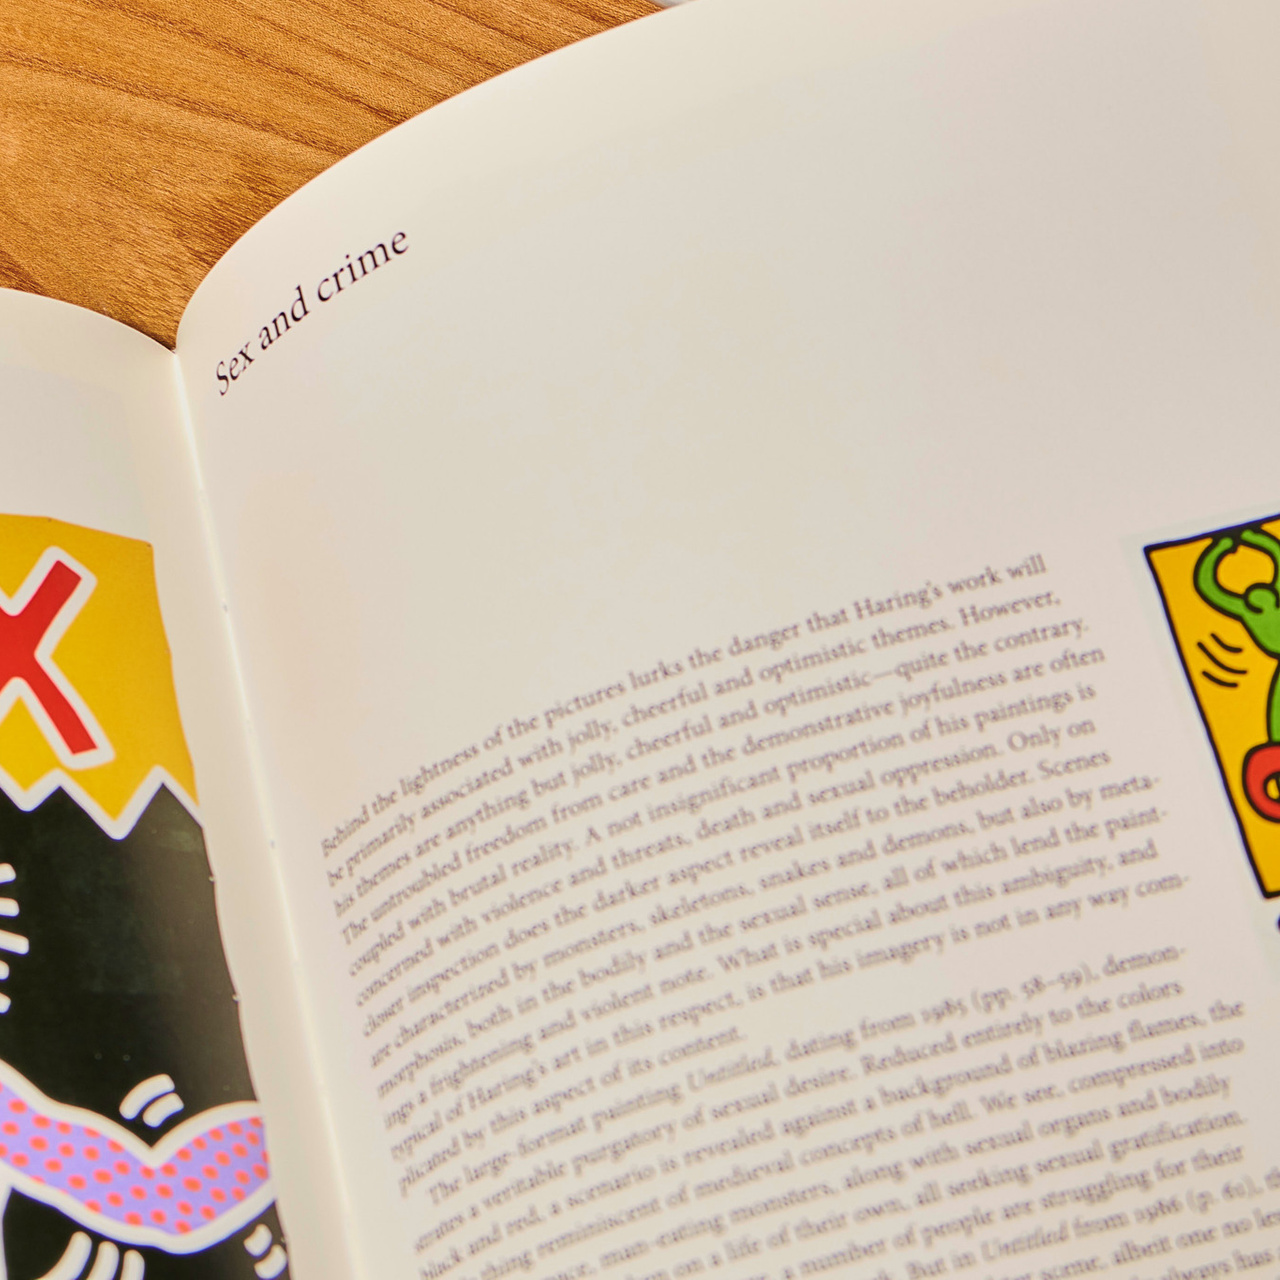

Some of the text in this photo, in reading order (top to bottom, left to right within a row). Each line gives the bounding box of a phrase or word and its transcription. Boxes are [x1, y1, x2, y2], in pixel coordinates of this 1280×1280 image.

[216, 231, 409, 396] Sex and crime
[345, 812, 416, 878] primarily
[421, 756, 514, 820] associated
[517, 737, 564, 768] with
[621, 681, 709, 727] cheerful
[714, 666, 754, 696] and
[758, 639, 867, 684] optimistic
[355, 852, 412, 898] themes
[415, 833, 441, 858] are
[445, 789, 531, 840] anything
[530, 771, 567, 797] but
[625, 714, 713, 761] cheerful
[718, 699, 759, 729] and
[953, 640, 988, 662] the
[370, 850, 463, 923] untroubled
[465, 816, 548, 864] freedom
[550, 793, 604, 824] from
[607, 776, 650, 802] care
[657, 753, 698, 785] and
[700, 746, 736, 769] the
[741, 701, 894, 756] demonstrative
[899, 672, 1008, 716] joyfulness
[1013, 663, 1044, 683] are
[1049, 648, 1106, 673] often
[371, 790, 398, 815] the
[399, 745, 480, 797] lightness
[483, 725, 503, 751] of
[506, 716, 539, 739] the
[543, 682, 627, 730] pictures
[628, 660, 685, 690] lurks
[687, 648, 722, 670] the
[728, 624, 800, 657] danger
[805, 608, 849, 633] that
[947, 566, 1002, 594] work
[1006, 553, 1047, 579] will
[407, 898, 447, 930] with
[447, 863, 507, 907] brutal
[586, 826, 602, 846] A
[606, 811, 643, 838] not
[647, 765, 781, 823] insignificant
[785, 733, 906, 784] proportion
[909, 718, 932, 743] of
[934, 715, 970, 737] his
[973, 691, 1074, 733] paintings
[1076, 682, 1097, 701] is
[394, 967, 510, 1049] characterized
[511, 960, 538, 981] by
[759, 860, 831, 890] snakes
[836, 839, 878, 869] and
[975, 807, 1015, 830] but
[1021, 796, 1064, 820] also
[1064, 787, 1093, 811] by
[407, 943, 501, 1004] inspection
[503, 920, 551, 950] does
[553, 904, 587, 927] the
[592, 876, 660, 912] darker
[667, 850, 734, 886] aspect
[739, 825, 805, 862] reveal
[808, 808, 861, 841] itself
[865, 807, 890, 825] to
[893, 795, 928, 817] the
[1036, 751, 1111, 780] Scenes
[436, 916, 478, 948] with
[480, 879, 563, 924] violence
[568, 855, 608, 888] and
[695, 806, 757, 840] death
[762, 790, 803, 820] and
[807, 769, 876, 806] sexual
[1006, 724, 1061, 752] Only
[1066, 719, 1096, 738] on
[465, 1004, 513, 1039] both
[516, 996, 539, 1015] in
[541, 979, 575, 1003] the
[653, 930, 694, 961] and
[697, 923, 733, 945] the
[739, 895, 808, 932] sexual
[882, 865, 910, 891] all
[913, 857, 937, 882] of
[940, 842, 1009, 873] which
[1009, 826, 1061, 857] lend
[1064, 821, 1099, 844] the
[418, 1091, 428, 1105] a
[429, 1033, 536, 1097] frightening
[538, 1008, 578, 1042] and
[580, 983, 654, 1022] violent
[716, 942, 779, 972] What
[784, 939, 804, 955] is
[807, 908, 883, 952] special
[888, 894, 949, 925] about
[952, 884, 996, 907] this
[1118, 838, 1159, 867] and
[445, 1096, 465, 1123] of
[552, 1046, 582, 1071] art
[585, 1038, 609, 1057] in
[612, 1023, 655, 1047] this
[746, 986, 767, 1002] is
[769, 968, 814, 994] that
[816, 960, 853, 980] his
[856, 934, 945, 969] imagery
[950, 927, 970, 944] is
[973, 914, 1012, 938] not
[1015, 909, 1040, 927] in
[1045, 898, 1082, 920] any
[1087, 887, 1129, 907] way
[461, 1128, 486, 1149] by
[489, 1109, 528, 1135] this
[532, 1077, 596, 1116] aspect
[600, 1061, 623, 1087] of
[627, 1058, 655, 1077] its
